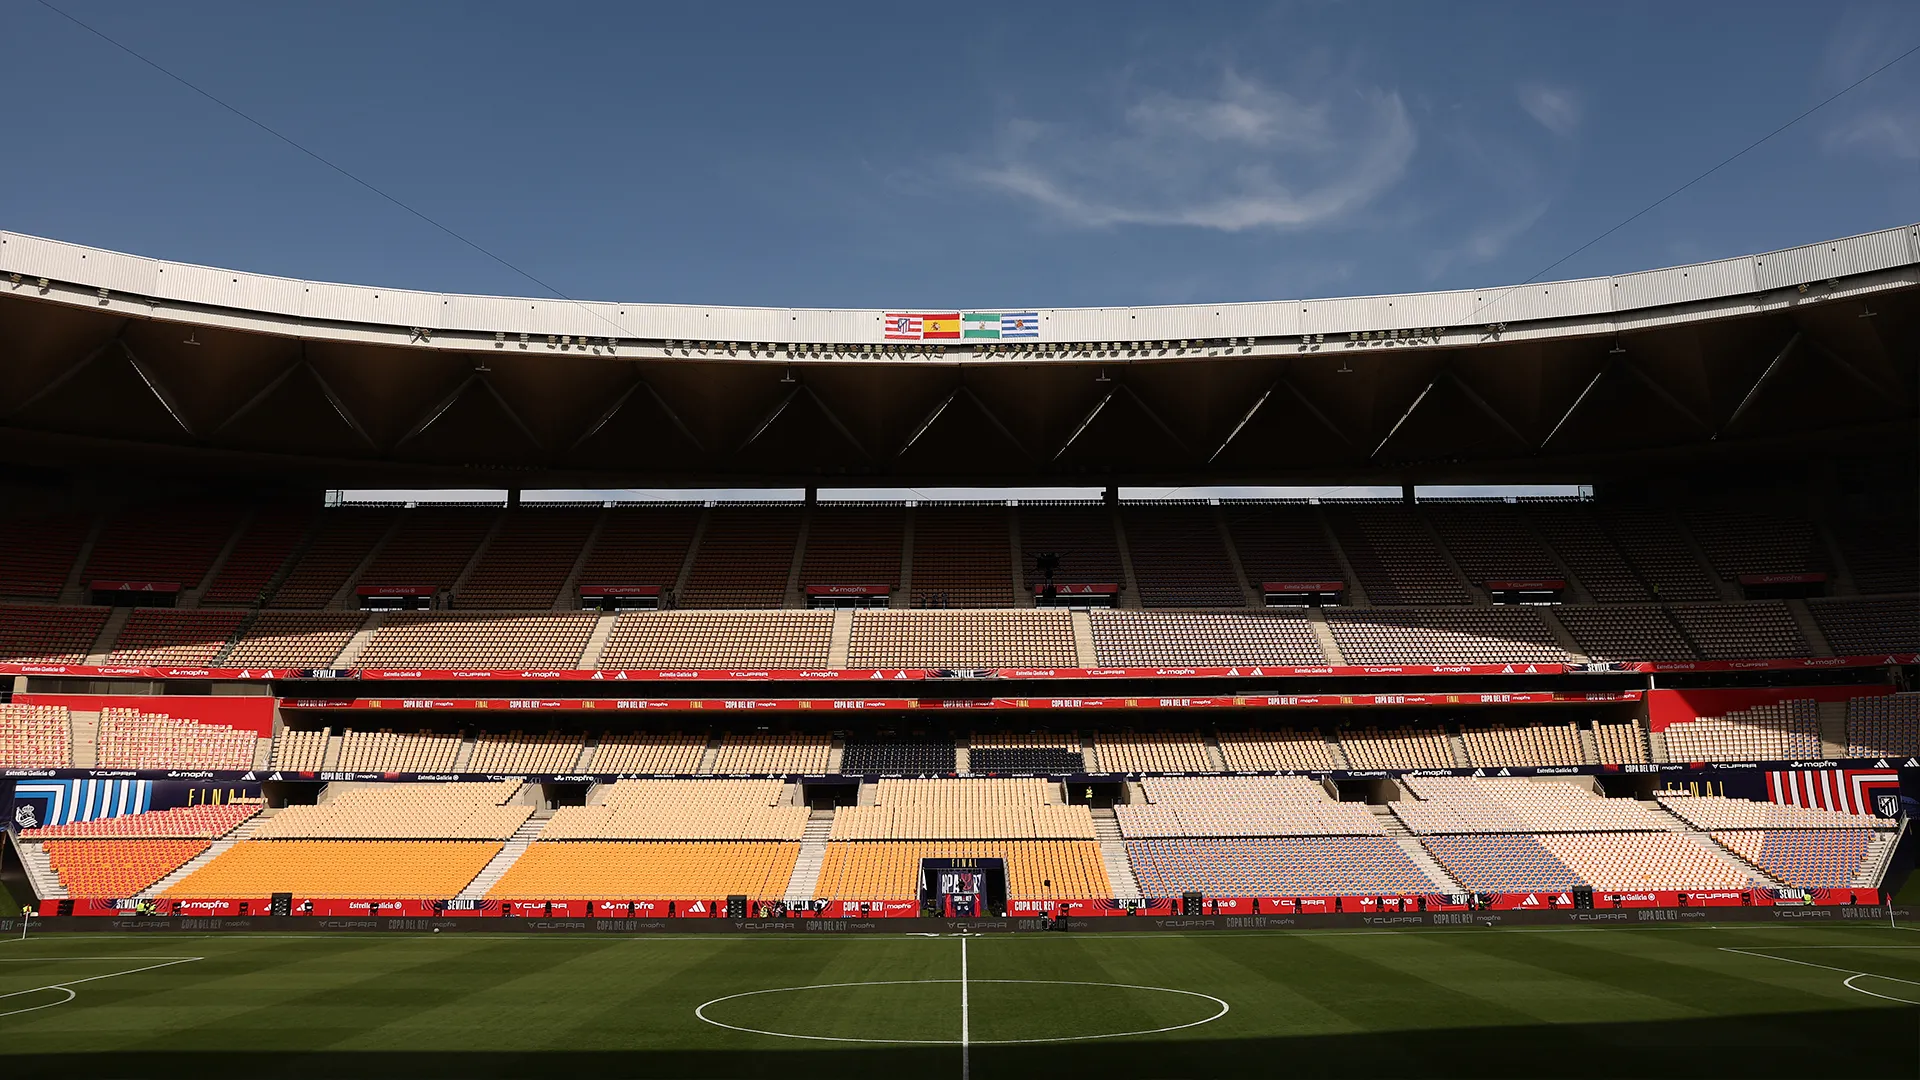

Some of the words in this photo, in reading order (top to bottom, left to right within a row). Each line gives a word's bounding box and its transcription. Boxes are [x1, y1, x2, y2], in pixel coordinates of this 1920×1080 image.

[1587, 663, 1610, 672] SEVILLA
[312, 670, 336, 678] SEVILLA
[950, 670, 974, 678] SEVILLA
[1160, 699, 1172, 707] COPA
[1172, 699, 1181, 707] DEL
[1182, 699, 1190, 707] REY
[1232, 698, 1246, 706] FINAL
[1268, 697, 1280, 705] COPA
[1280, 697, 1289, 705] DEL
[1289, 697, 1298, 705] REY
[1340, 696, 1353, 704] FINAL
[1375, 696, 1387, 704] COPA
[1387, 696, 1396, 704] DEL
[1396, 696, 1404, 704] REY
[1446, 695, 1460, 703] FINAL
[1480, 694, 1493, 703] COPA
[1493, 694, 1502, 703] DEL
[1502, 694, 1511, 703] REY
[403, 700, 416, 708] COPA
[416, 700, 424, 708] DEL
[424, 700, 433, 708] REY
[1051, 700, 1064, 708] COPA
[1064, 700, 1073, 708] DEL
[1073, 700, 1082, 708] REY
[1625, 764, 1639, 773] COPA
[1639, 764, 1649, 773] DEL
[1649, 764, 1659, 773] REY
[1803, 760, 1838, 768] mapfre
[180, 770, 214, 779] mapfre
[320, 772, 335, 781] COPA
[335, 772, 345, 781] DEL
[345, 772, 355, 781] REY
[1422, 769, 1452, 778] mapfre
[951, 858, 978, 868] FINAL
[116, 898, 144, 910] SEVILL
[188, 900, 229, 910] mapfre
[447, 900, 474, 910] SEVILLA
[843, 902, 860, 912] COPA
[872, 901, 884, 912] REY
[1014, 901, 1031, 911] COPA
[1031, 901, 1043, 911] DEL
[1044, 901, 1055, 911] REY
[1638, 910, 1654, 920] COPA
[1655, 910, 1666, 920] DEL
[1666, 910, 1678, 920] REY
[1842, 908, 1858, 918] COPA
[1858, 908, 1870, 918] DEL
[1870, 908, 1882, 918] REY
[1226, 917, 1243, 927] COPA
[1243, 917, 1254, 927] DEL
[1255, 917, 1267, 927] REY
[1433, 914, 1450, 924] COPA
[1450, 914, 1461, 924] DEL
[1462, 914, 1474, 924] REY
[388, 920, 405, 930] COPA
[405, 920, 416, 930] DEL
[417, 920, 428, 930] REY
[596, 921, 613, 930] COPA
[613, 921, 625, 930] DEL
[626, 921, 637, 930] REY
[806, 921, 823, 930] COPA
[823, 921, 835, 930] DEL
[835, 921, 847, 930] REY
